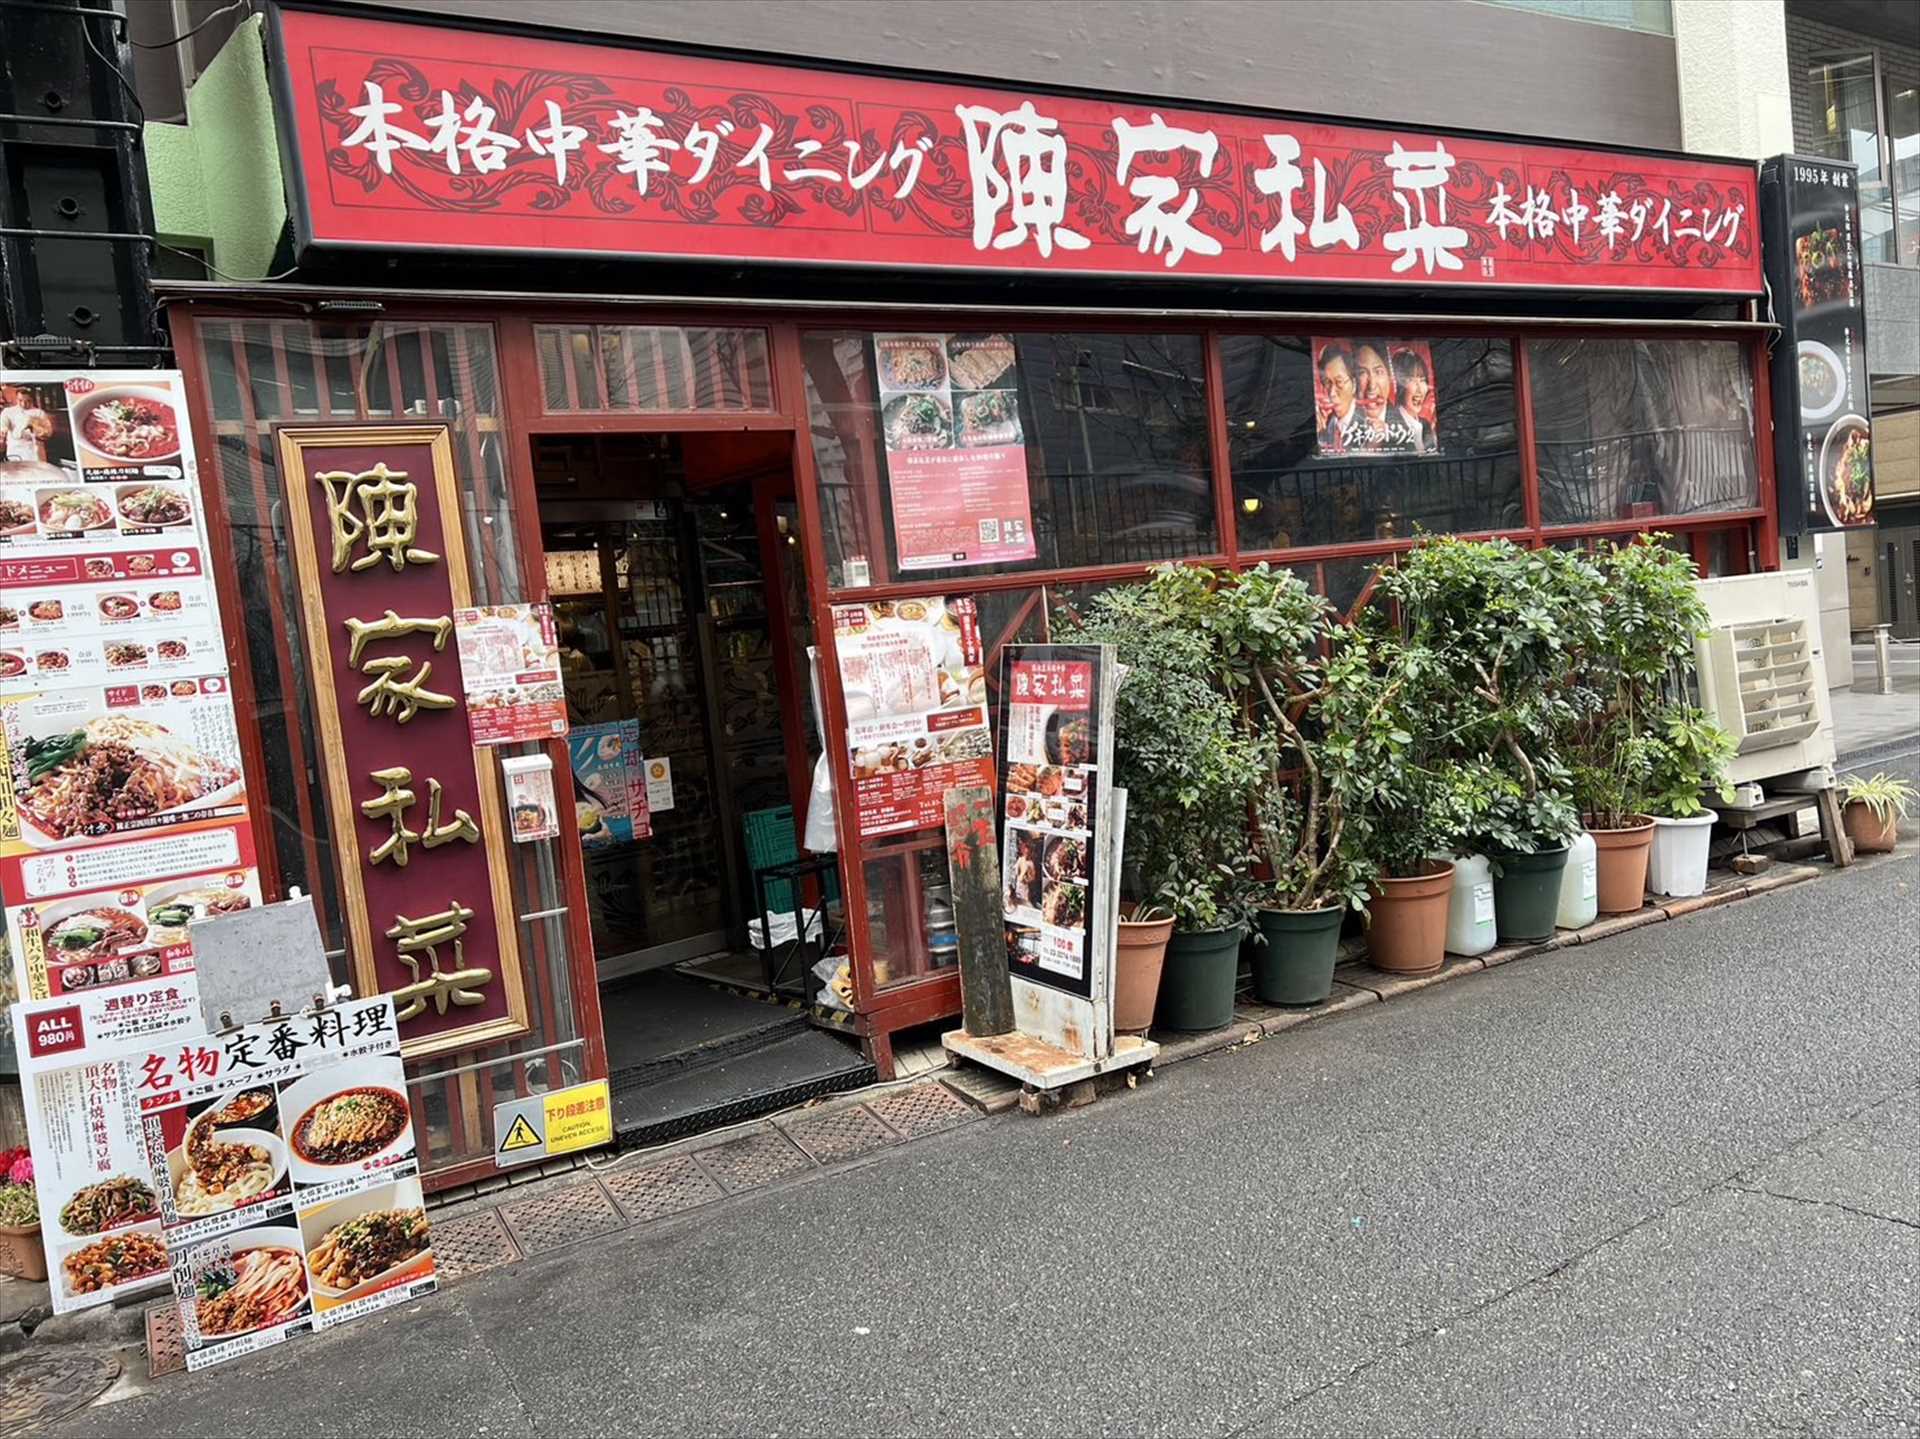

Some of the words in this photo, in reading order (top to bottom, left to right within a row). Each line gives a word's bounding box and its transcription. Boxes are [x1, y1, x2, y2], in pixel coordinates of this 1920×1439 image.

[341, 80, 935, 201] 本格中華ダイニング
[954, 100, 1470, 275] 陳家私菜
[1487, 180, 1747, 246] 本格中華ダイニング
[1793, 166, 1829, 185] 1995年
[314, 461, 493, 1021] 陳家私菜
[104, 987, 179, 1012] 週替り定食
[37, 1017, 72, 1033] ALL
[148, 1013, 170, 1023] スープ
[38, 1030, 75, 1047] 980円
[104, 1029, 126, 1040] サラダ
[137, 1003, 393, 1091] 名物定番料理
[227, 1075, 252, 1087] スープ
[264, 1065, 291, 1078] サラダ
[144, 1092, 178, 1109] ランチ
[546, 1096, 605, 1122] 下り段差注意
[551, 1132, 577, 1143] UNEVEN
[578, 1126, 604, 1136] ACCESS
[562, 1121, 591, 1133] CAUTION
